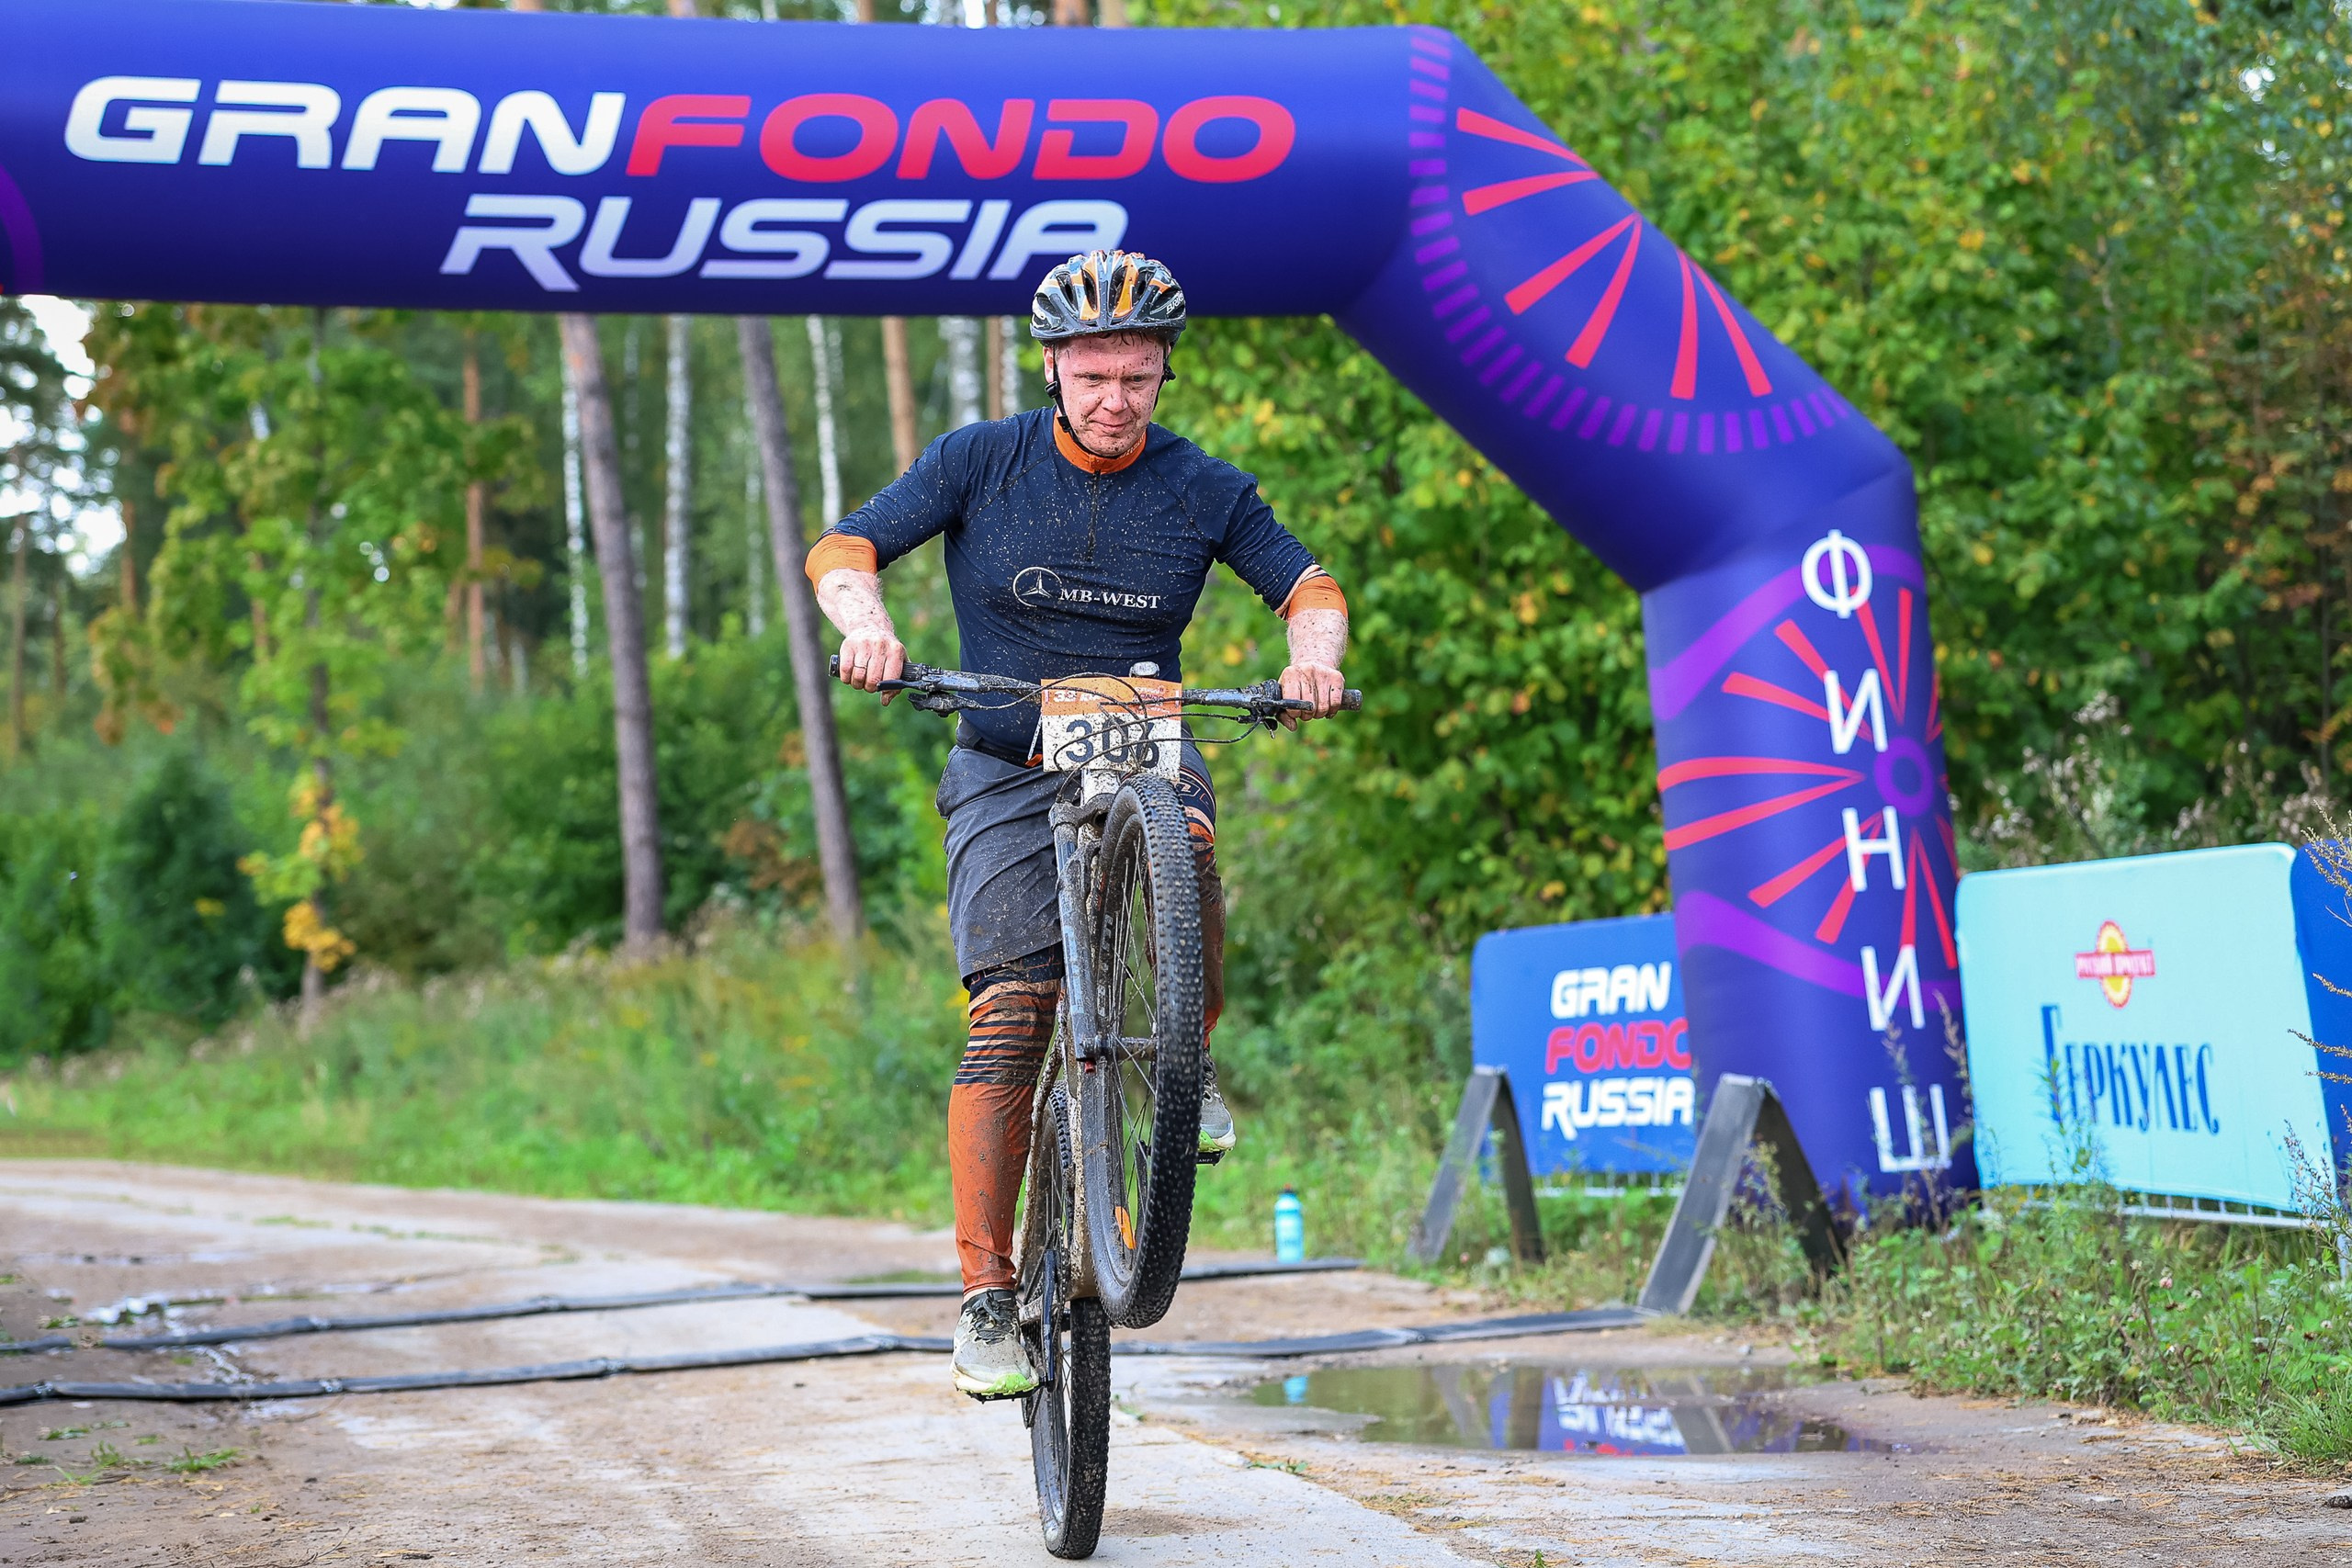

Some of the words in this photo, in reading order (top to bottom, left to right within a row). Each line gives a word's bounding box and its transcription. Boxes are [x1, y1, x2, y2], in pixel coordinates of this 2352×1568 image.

[439, 194, 1128, 293] RUSSIA
[1059, 588, 1161, 609] MB-WEST
[1800, 528, 1953, 1174] ФИНИШ
[1550, 962, 1671, 1018] GRAN
[1541, 1077, 1695, 1142] RUSSIA
